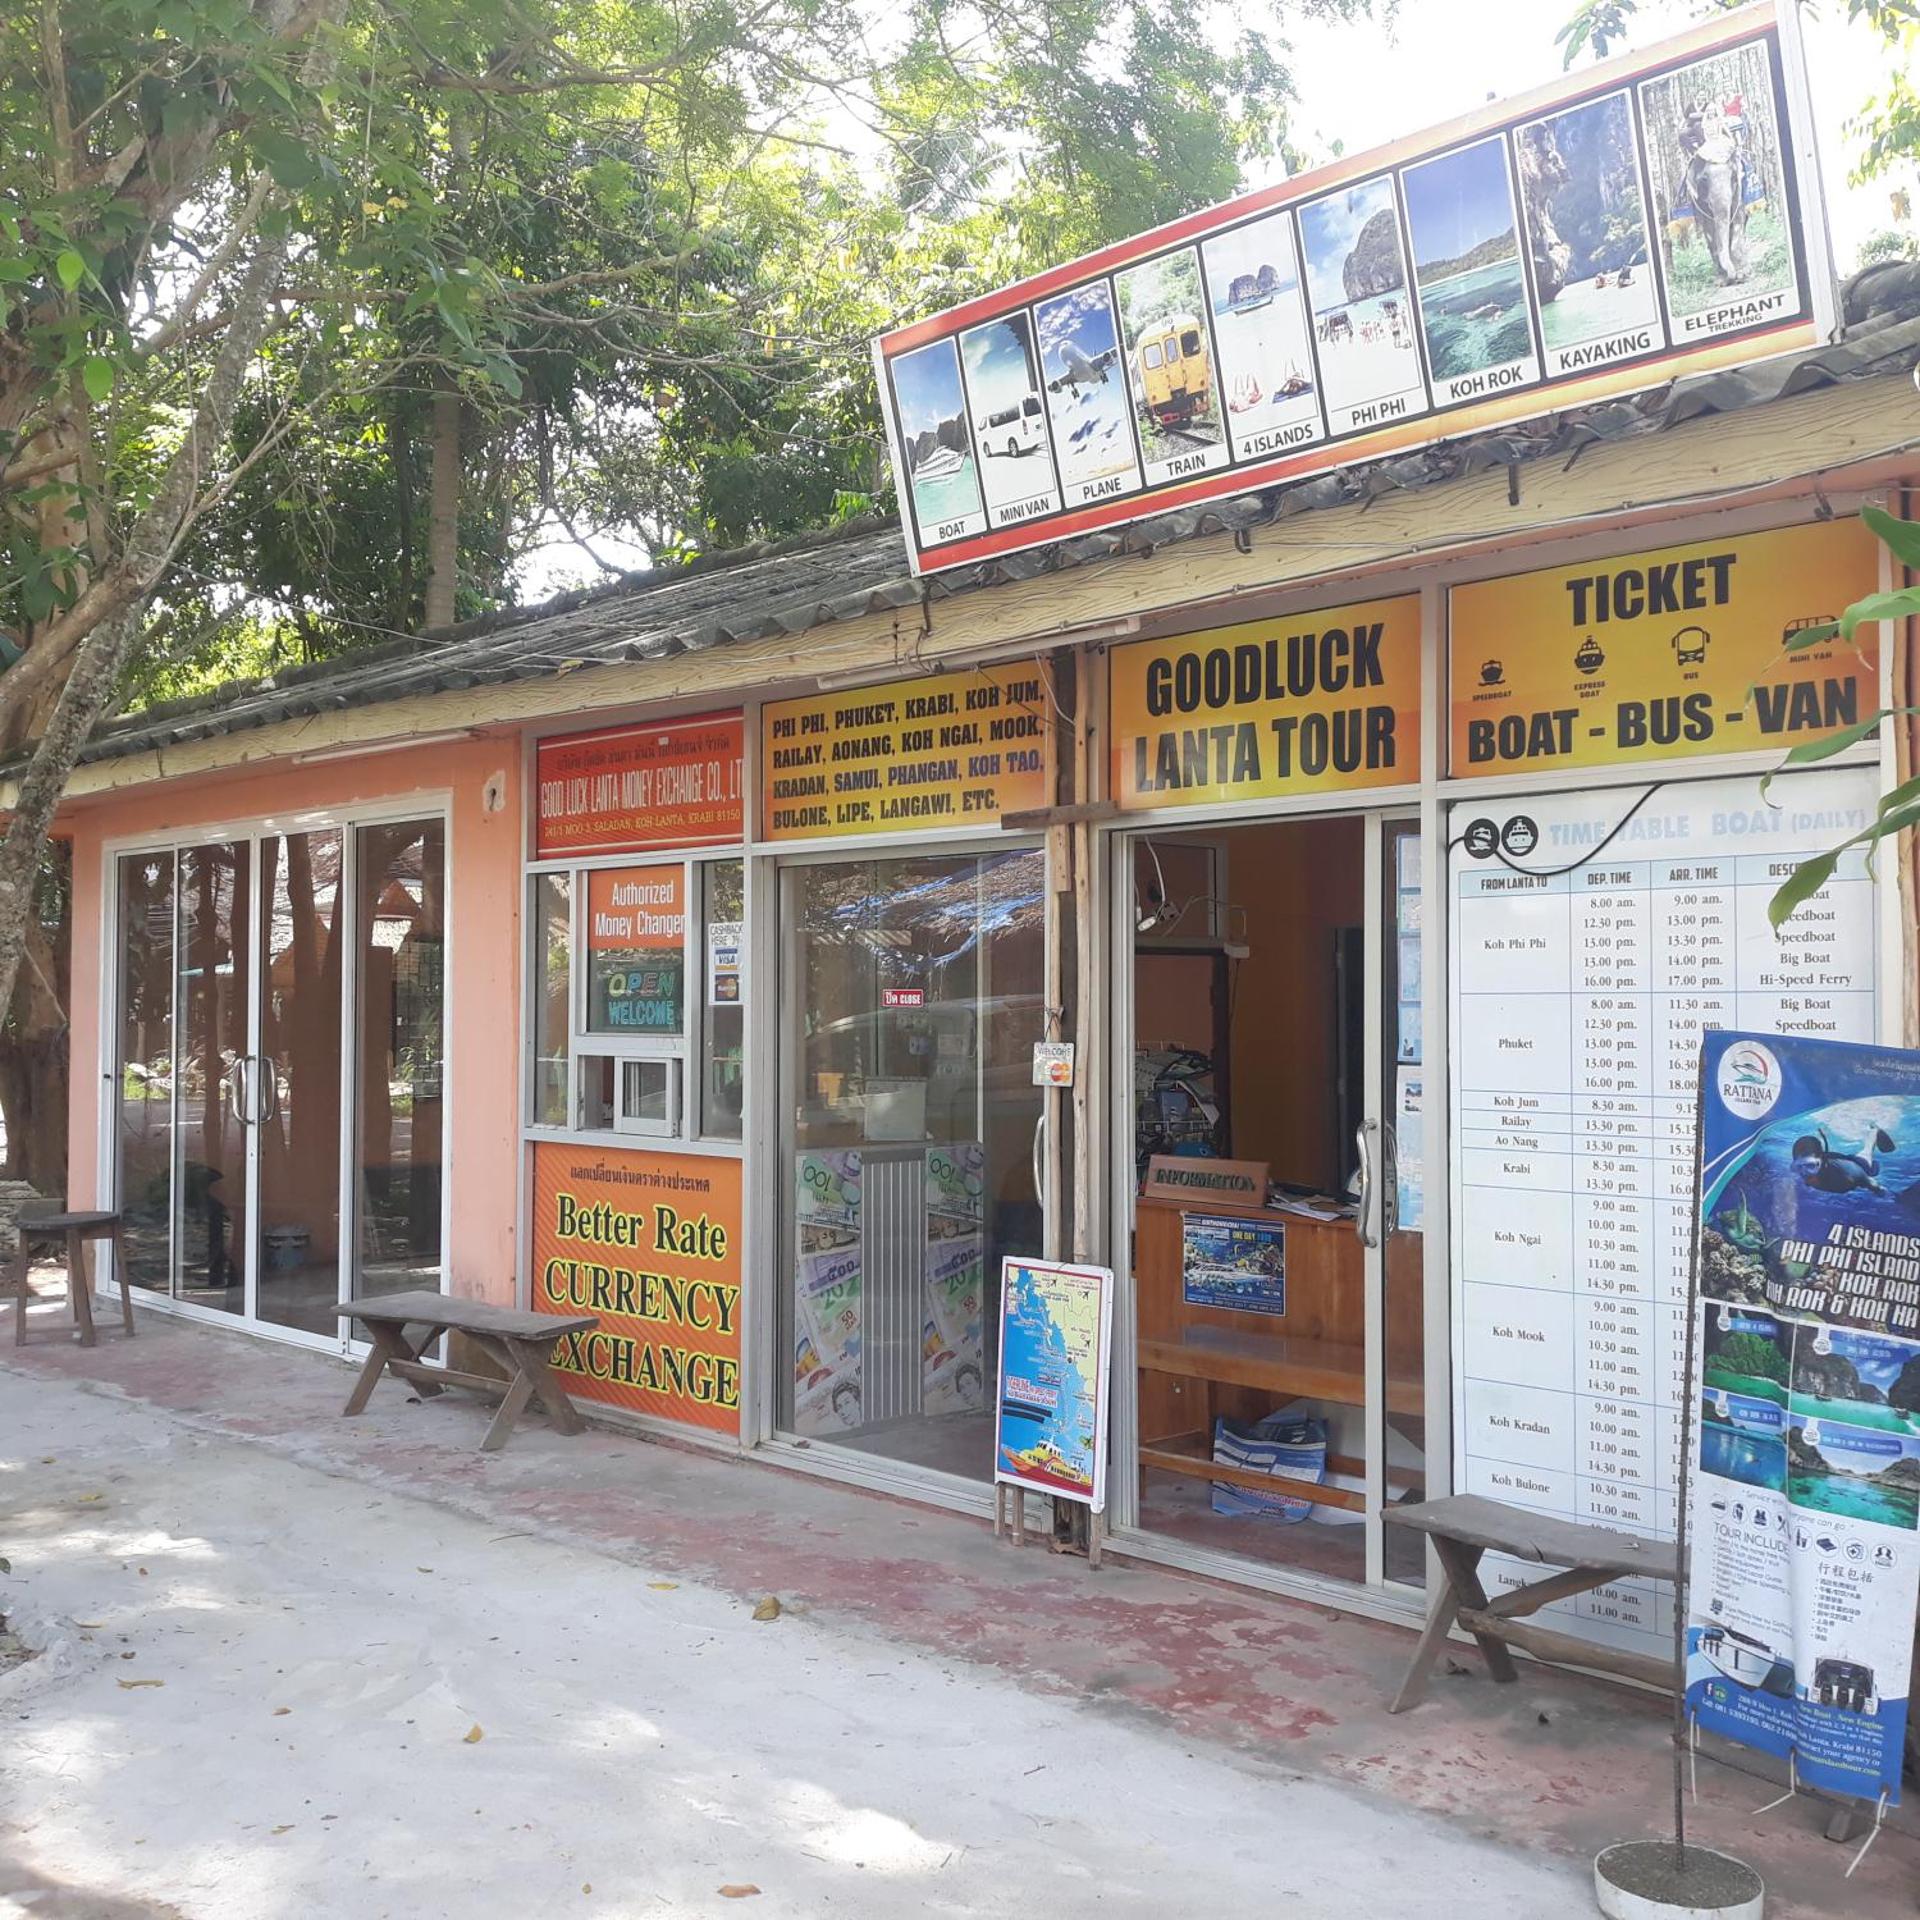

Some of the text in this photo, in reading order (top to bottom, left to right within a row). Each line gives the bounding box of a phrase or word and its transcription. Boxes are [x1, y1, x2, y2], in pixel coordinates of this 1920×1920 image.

[1685, 294, 1785, 331] ELEPHANT
[1708, 313, 1763, 333] TREKKING
[1560, 332, 1651, 370] KAYAKING
[1450, 365, 1523, 399] KOH ROK
[1352, 398, 1406, 426] PHI PHI
[1243, 424, 1313, 455] 4 ISLANDS
[1166, 454, 1206, 476] TRAIN
[1083, 477, 1121, 499] PLANE
[1000, 498, 1050, 523] MINI VAN
[938, 521, 966, 539] BOAT
[1565, 553, 1737, 627] TICKET
[1146, 622, 1384, 717] GOODLUCK
[1683, 672, 1699, 681] BUS
[1472, 690, 1512, 701] SPEEDBOAT
[1573, 680, 1605, 692] EXPRESS
[1580, 689, 1600, 699] BOAT
[773, 680, 1044, 739] PHI PHI, PHUKET, KRABI, KOH JUM,
[1468, 708, 1579, 763] BOAT
[1617, 693, 1713, 748] BUS
[1753, 676, 1857, 734] VAN
[773, 715, 1044, 768] RAILAY, AONANG, KOH NGAI, MOOK,
[1134, 705, 1396, 794] LANTA TOUR
[773, 749, 1044, 799] KRADAN, SAMUI, PHANGAN, KOH TAO,
[541, 780, 564, 819] GOOD
[566, 776, 588, 816] LUCK
[591, 772, 619, 812] LANTA
[622, 768, 654, 810] MONEY
[656, 762, 703, 806] EXCHANGE
[707, 761, 728, 803] CO.,
[773, 788, 999, 830] BULONE, LIPE, LANGAWI, ETC.
[636, 816, 654, 829] KOH
[689, 811, 714, 824] KRABI
[1550, 821, 1606, 846] TIME
[1712, 810, 1783, 836] BOAT
[1792, 809, 1865, 834] (DAILY)
[1587, 871, 1631, 886] DEP. TIME
[1669, 866, 1718, 881] ARR. TIME
[611, 880, 674, 906] Authorized
[1481, 878, 1507, 891] FROM
[1507, 876, 1534, 889] LANTA
[1590, 898, 1636, 909] 8.00 am.
[1674, 895, 1722, 907] 9.00 am.
[595, 911, 687, 939] Money Changer
[1484, 938, 1546, 950] Koh Phi Phi
[1775, 931, 1836, 946] Speedboat
[718, 955, 736, 965] VISA
[1780, 952, 1831, 966] Big Boat
[608, 972, 675, 997] OPEN
[1667, 975, 1723, 989] 17.00 pm.
[1760, 974, 1852, 988] Hi-Speed Ferry
[899, 994, 921, 1004] CLOSE
[1780, 998, 1831, 1012] Big Boat
[608, 1001, 675, 1025] WELCOME
[1775, 1020, 1836, 1034] Speedboat
[1498, 1038, 1533, 1049] Phuket
[1723, 1084, 1773, 1101] RATTANA
[1494, 1096, 1539, 1109] Koh Jum
[1591, 1100, 1638, 1112] 8.30 am.
[1501, 1116, 1532, 1129] Railay
[1494, 1136, 1539, 1149] Ao Nang
[1503, 1163, 1531, 1174] Krabi
[1155, 1168, 1256, 1192] INFORMATION
[557, 1193, 727, 1260] Better Rate
[1494, 1231, 1541, 1246] Koh Ngai
[1588, 1239, 1639, 1253] 10.30 am.
[1827, 1224, 1920, 1259] 4 ISLANDS
[1780, 1240, 1920, 1281] PHI PHI ISLAND
[544, 1258, 741, 1334] CURRENCY
[1838, 1272, 1920, 1305] KOH ROK
[1766, 1280, 1920, 1329] KOH ROK & KOH HA
[1493, 1326, 1545, 1342] Koh Mook
[1489, 1416, 1550, 1435] Koh Kradan
[1491, 1473, 1551, 1493] Koh Bulone
[1590, 1502, 1641, 1520] 11.00 am.
[1714, 1522, 1742, 1541] TOUR
